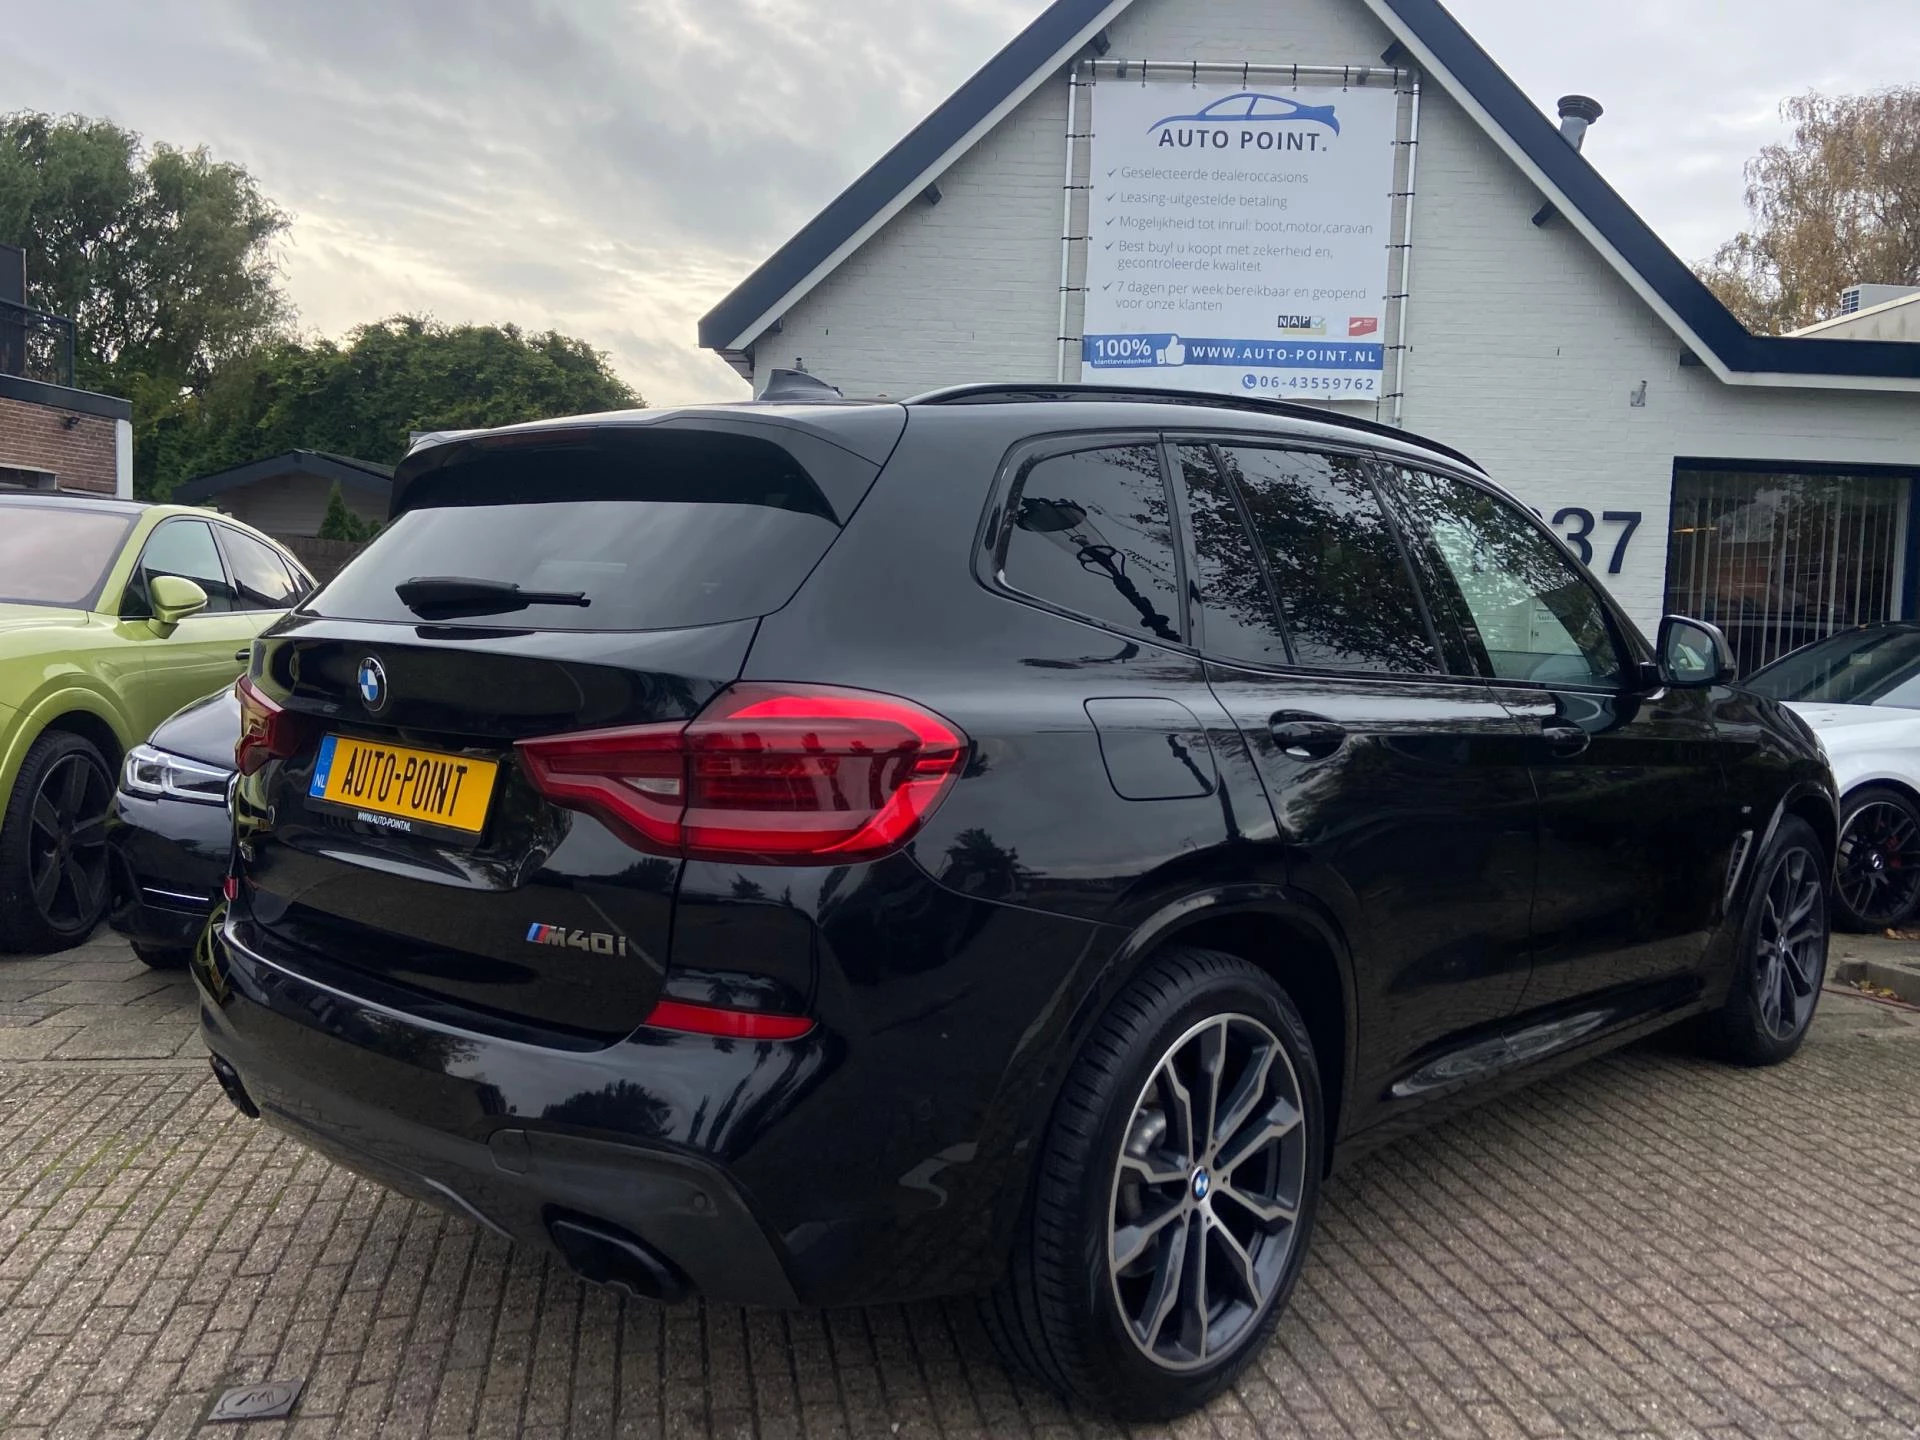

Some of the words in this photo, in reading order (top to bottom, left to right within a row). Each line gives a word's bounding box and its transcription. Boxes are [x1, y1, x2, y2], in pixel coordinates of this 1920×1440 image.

[1158, 128, 1229, 149] AUTO
[1121, 166, 1208, 181] Geselecteerde
[1211, 169, 1309, 183] dealeroccasions
[1120, 192, 1236, 208] Leasing-uitgestelde
[1239, 194, 1288, 210] betaling
[1119, 215, 1195, 231] Mogelijkheid
[1198, 219, 1215, 230] tot
[1254, 219, 1373, 235] boot,motor,caravan
[1119, 240, 1144, 252] Best
[1148, 241, 1174, 256] buy!
[1176, 244, 1185, 254] u
[1188, 242, 1222, 257] koopt
[1225, 245, 1249, 256] met
[1252, 244, 1312, 258] zekerheid
[1314, 248, 1334, 260] en,
[1117, 257, 1210, 272] gecontroleerde
[1212, 259, 1262, 272] kwaliteit
[1117, 281, 1125, 293] 7
[1127, 281, 1165, 296] dagen
[1168, 284, 1189, 296] per
[1191, 284, 1223, 296] week
[1226, 284, 1290, 297] bereikbaar
[1294, 287, 1309, 298] en
[1312, 287, 1367, 301] geopend
[1115, 298, 1144, 309] voor
[1146, 299, 1176, 310] onze
[1178, 299, 1223, 312] klanten
[1279, 316, 1311, 327] NAP
[1095, 338, 1151, 357] 100%
[1192, 345, 1376, 363] WWW.AUTO-POINT.NL
[1260, 375, 1374, 390] 06-43559762
[314, 774, 326, 788] NL
[341, 747, 468, 817] AUTO-POINT
[357, 811, 412, 832] WWW.AUTO-POINT.NL
[543, 925, 627, 957] M40i
